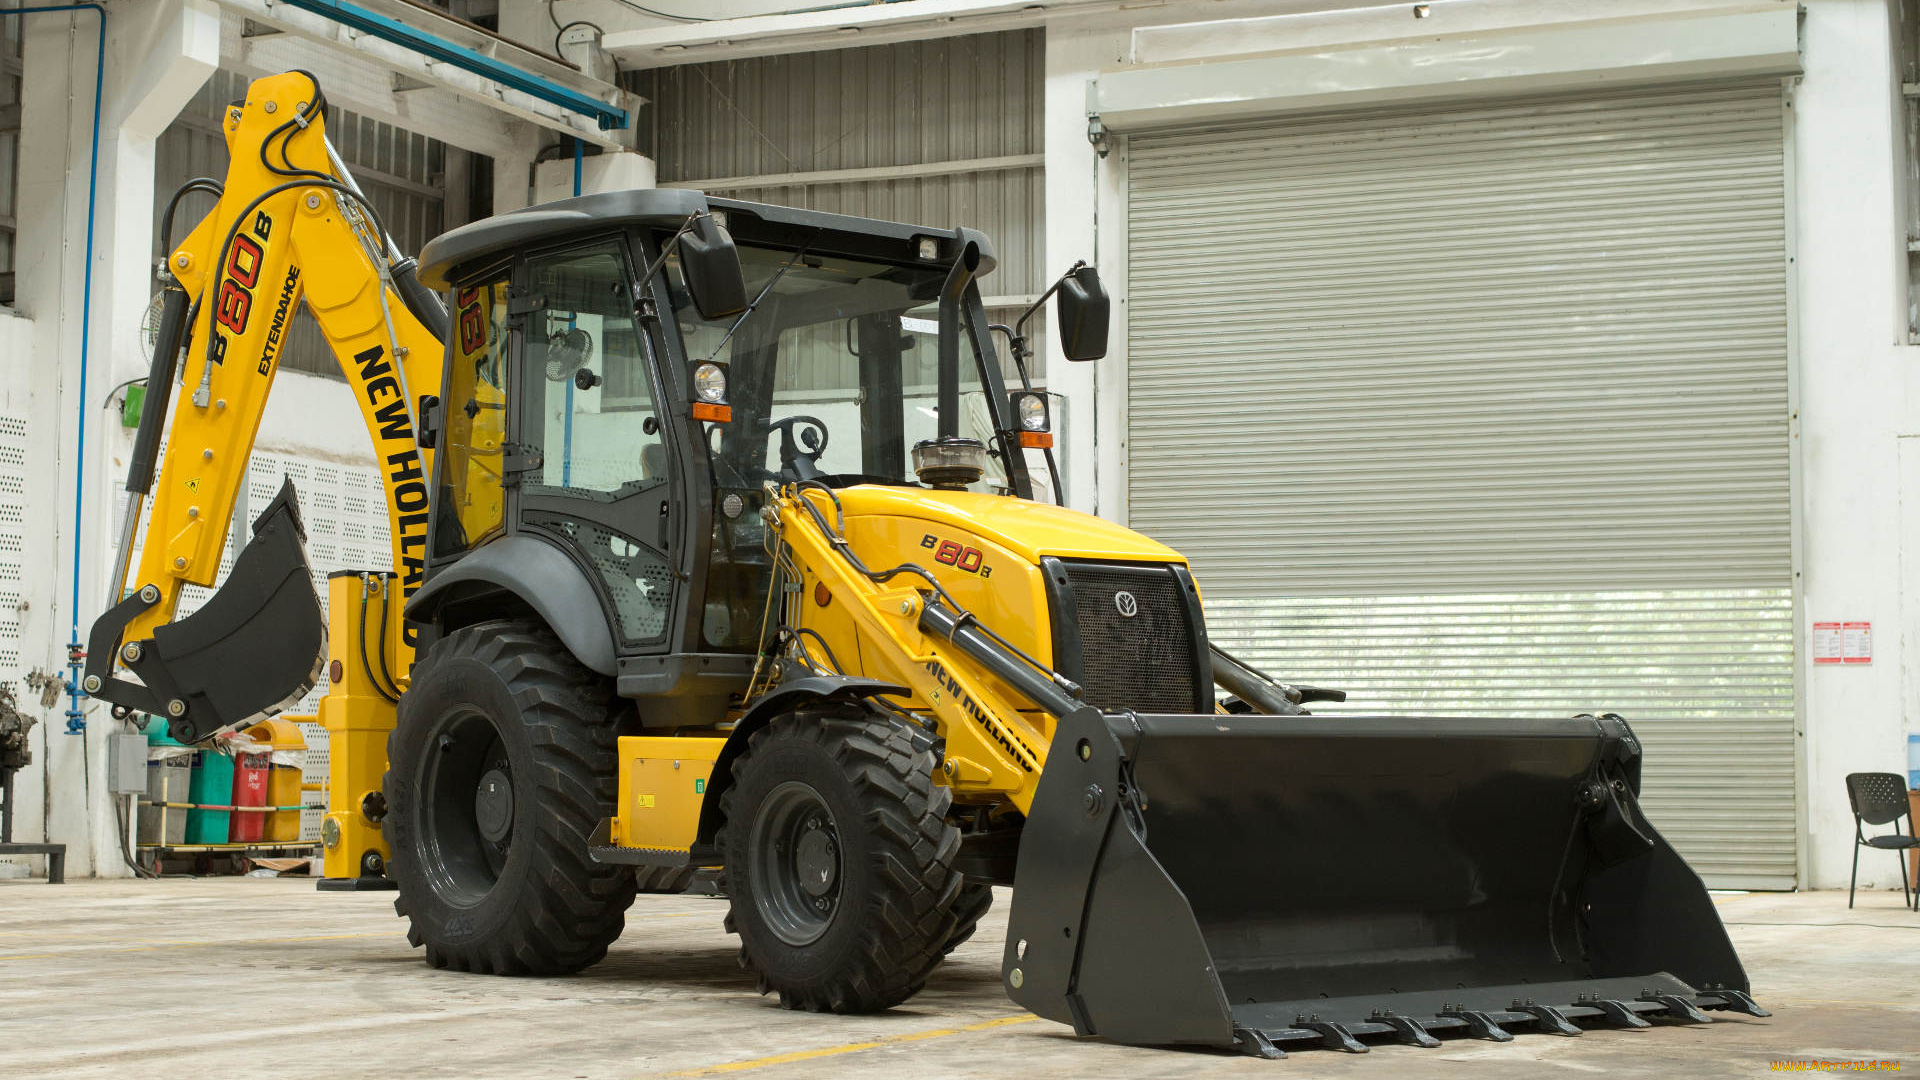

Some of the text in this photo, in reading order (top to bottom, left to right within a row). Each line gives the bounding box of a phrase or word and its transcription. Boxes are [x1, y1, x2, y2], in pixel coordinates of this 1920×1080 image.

[257, 264, 301, 377] EXTENDAHOE
[353, 344, 428, 648] NEW HOLLAD
